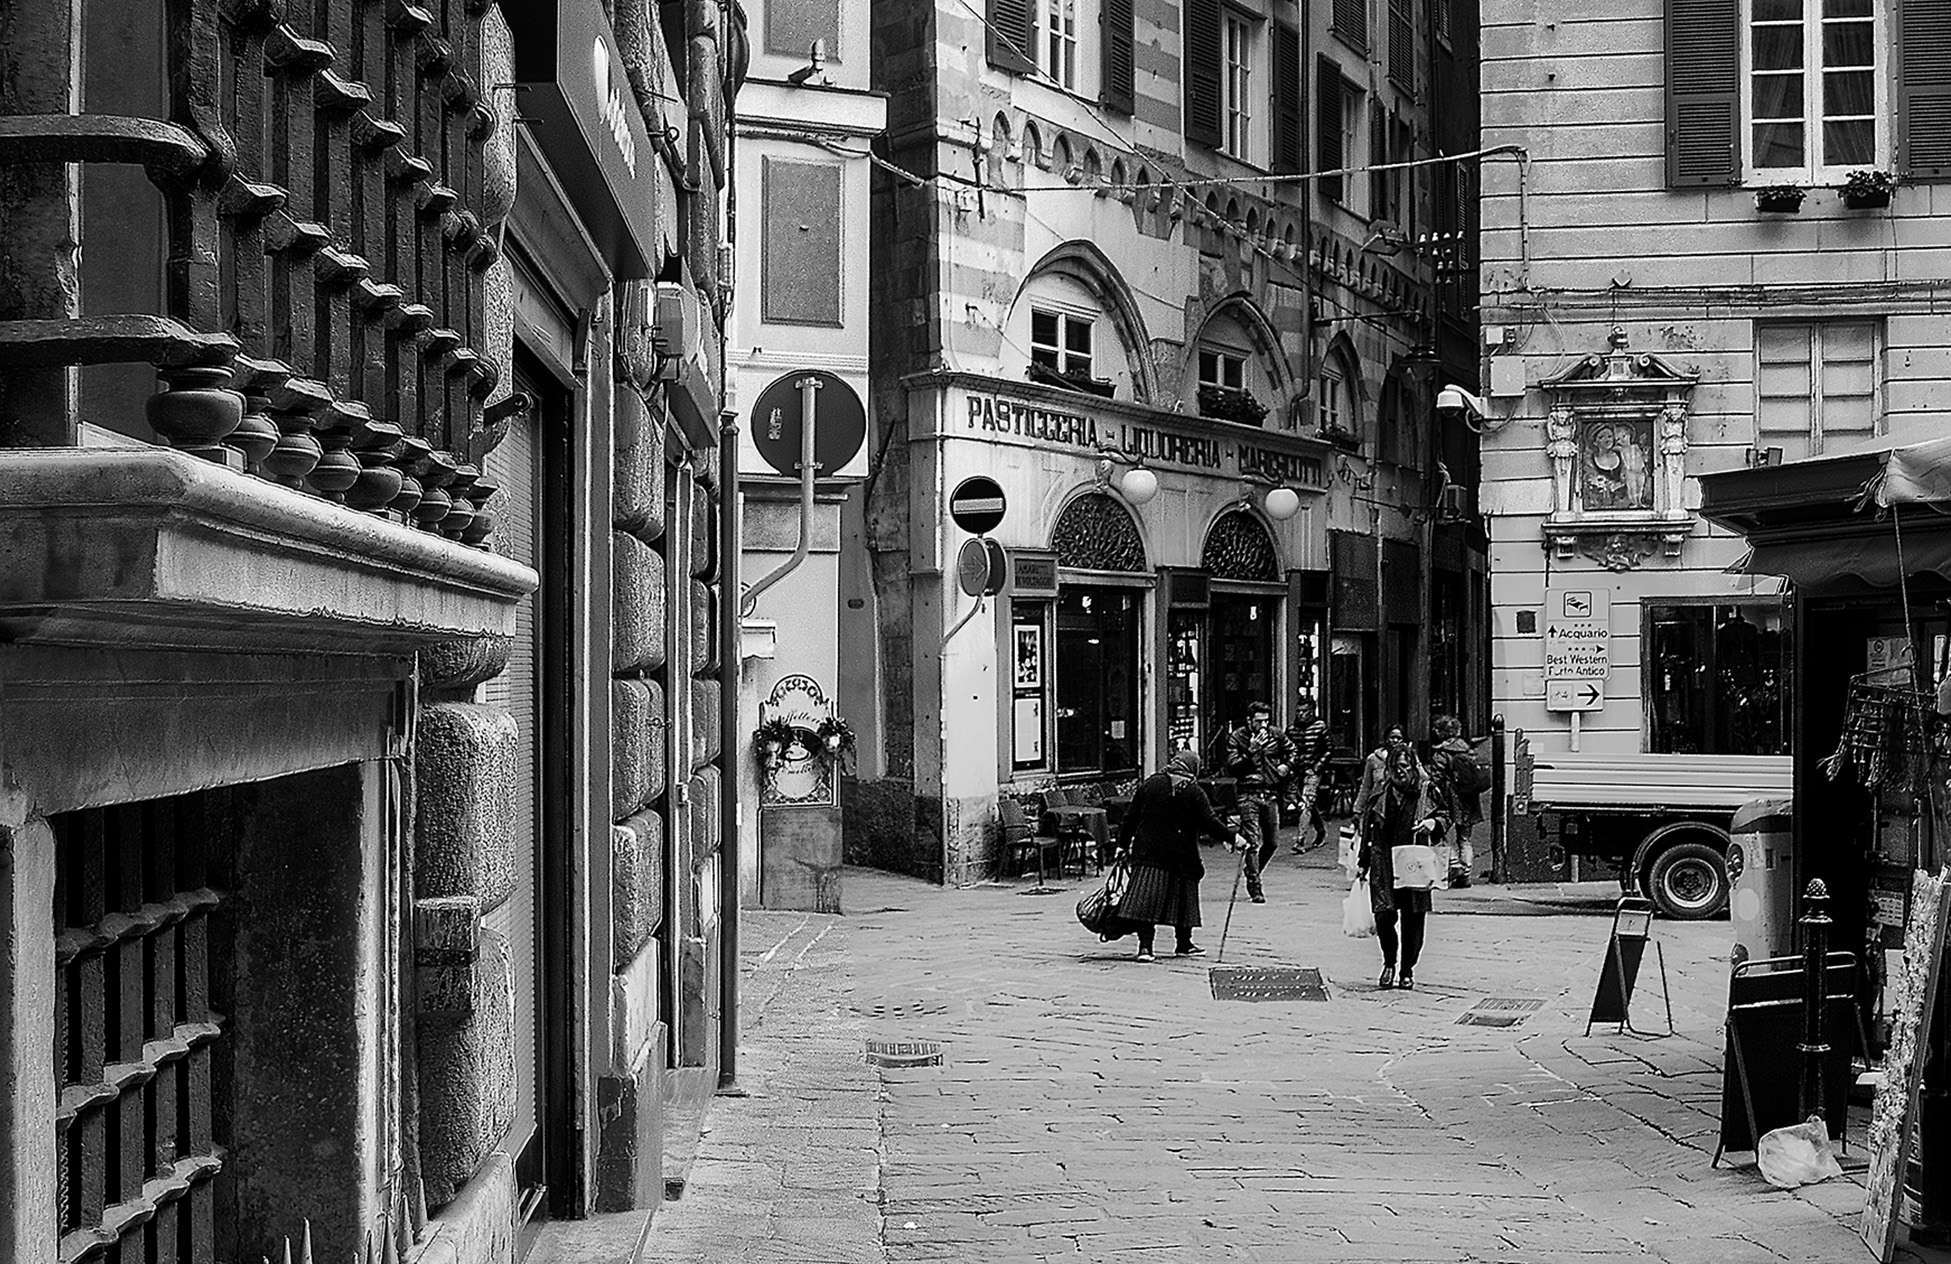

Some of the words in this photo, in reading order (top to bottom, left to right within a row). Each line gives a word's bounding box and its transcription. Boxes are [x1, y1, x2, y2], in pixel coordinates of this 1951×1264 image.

[966, 396, 1099, 449] PASTICCERIA
[1121, 424, 1221, 469] LIQUORERIA
[1559, 628, 1608, 639] Acquario
[1547, 655, 1567, 664] Best
[1570, 655, 1607, 664] Western
[1576, 666, 1605, 676] Antico
